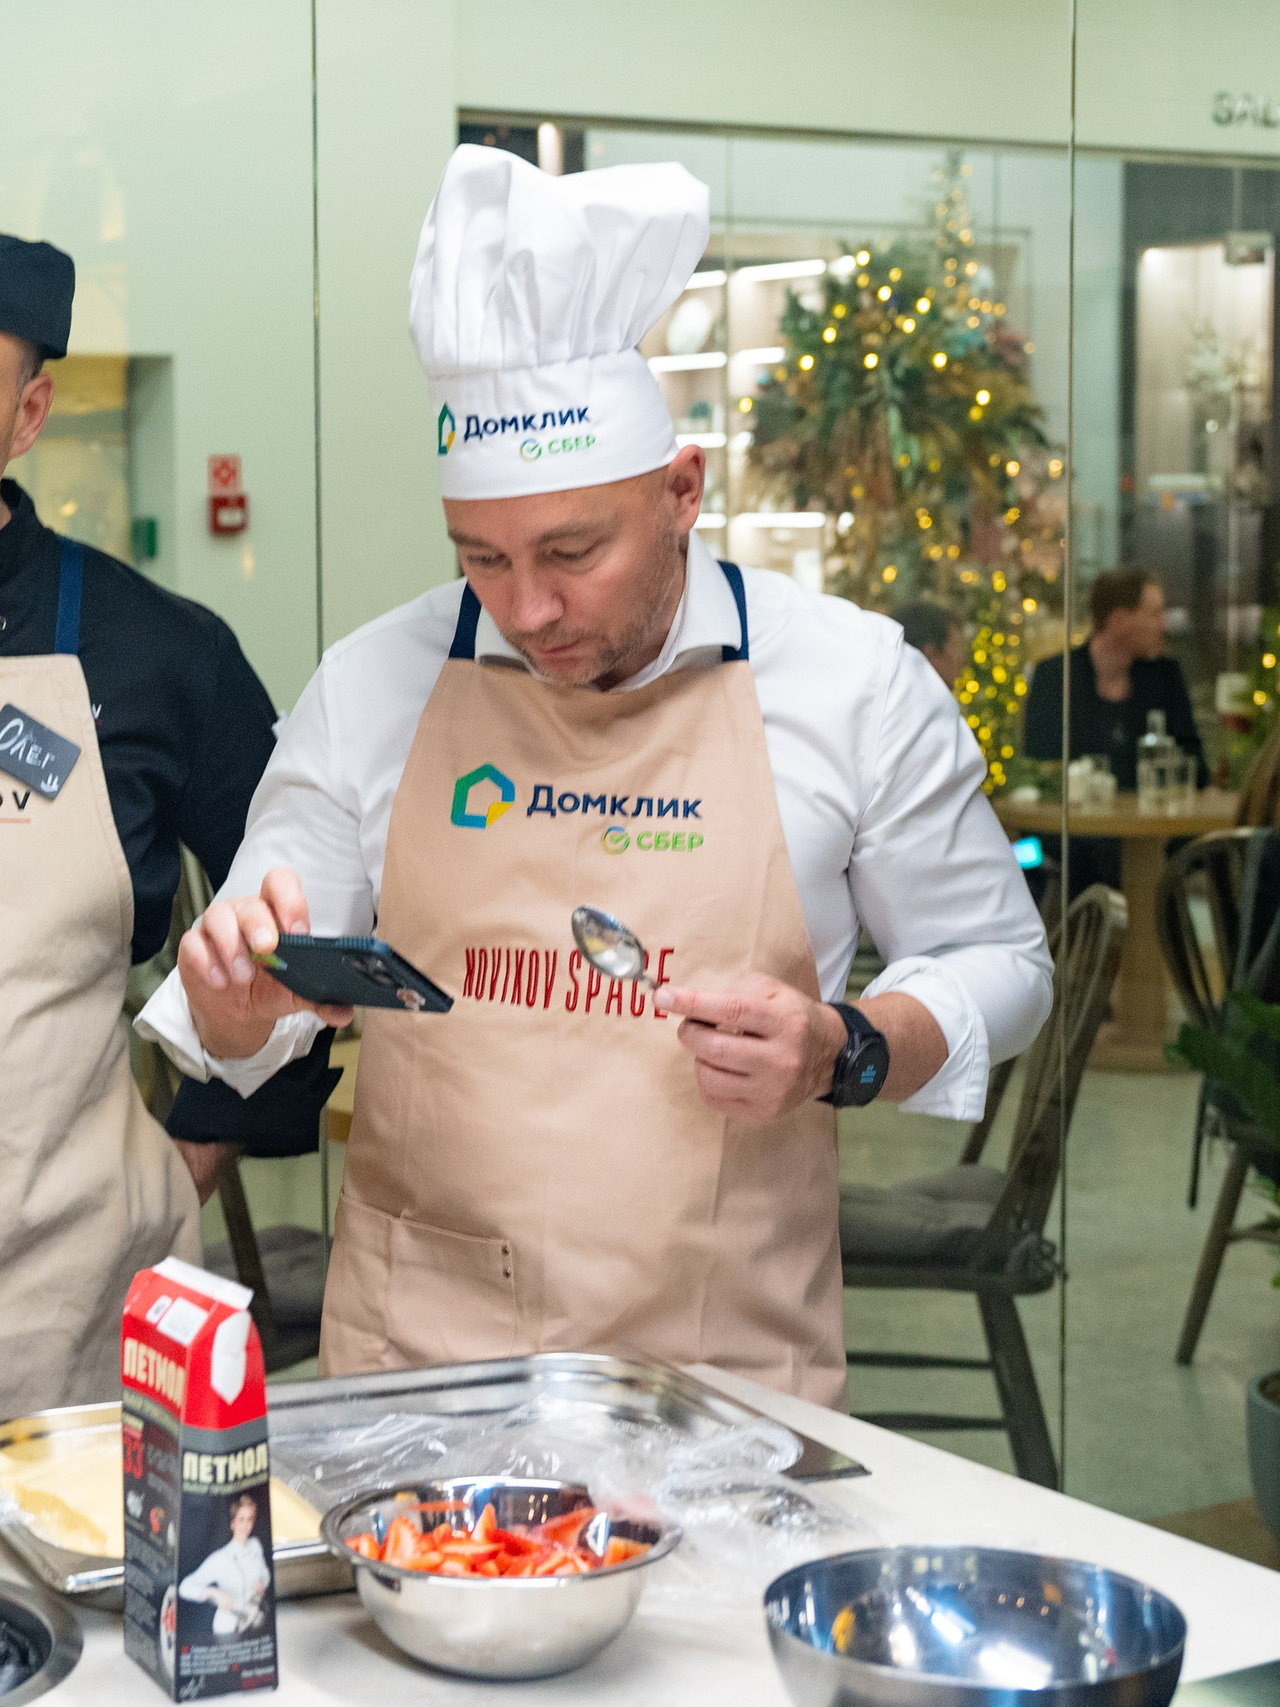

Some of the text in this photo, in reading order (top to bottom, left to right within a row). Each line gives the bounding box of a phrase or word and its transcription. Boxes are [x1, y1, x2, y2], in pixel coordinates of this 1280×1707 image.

[464, 406, 591, 443] Домклик
[548, 434, 596, 456] СБЕР
[527, 784, 702, 819] Домклик
[636, 831, 704, 852] СБЕР
[463, 947, 558, 1010] NOVIKOV
[183, 1442, 268, 1485] ПЕТМОЛ
